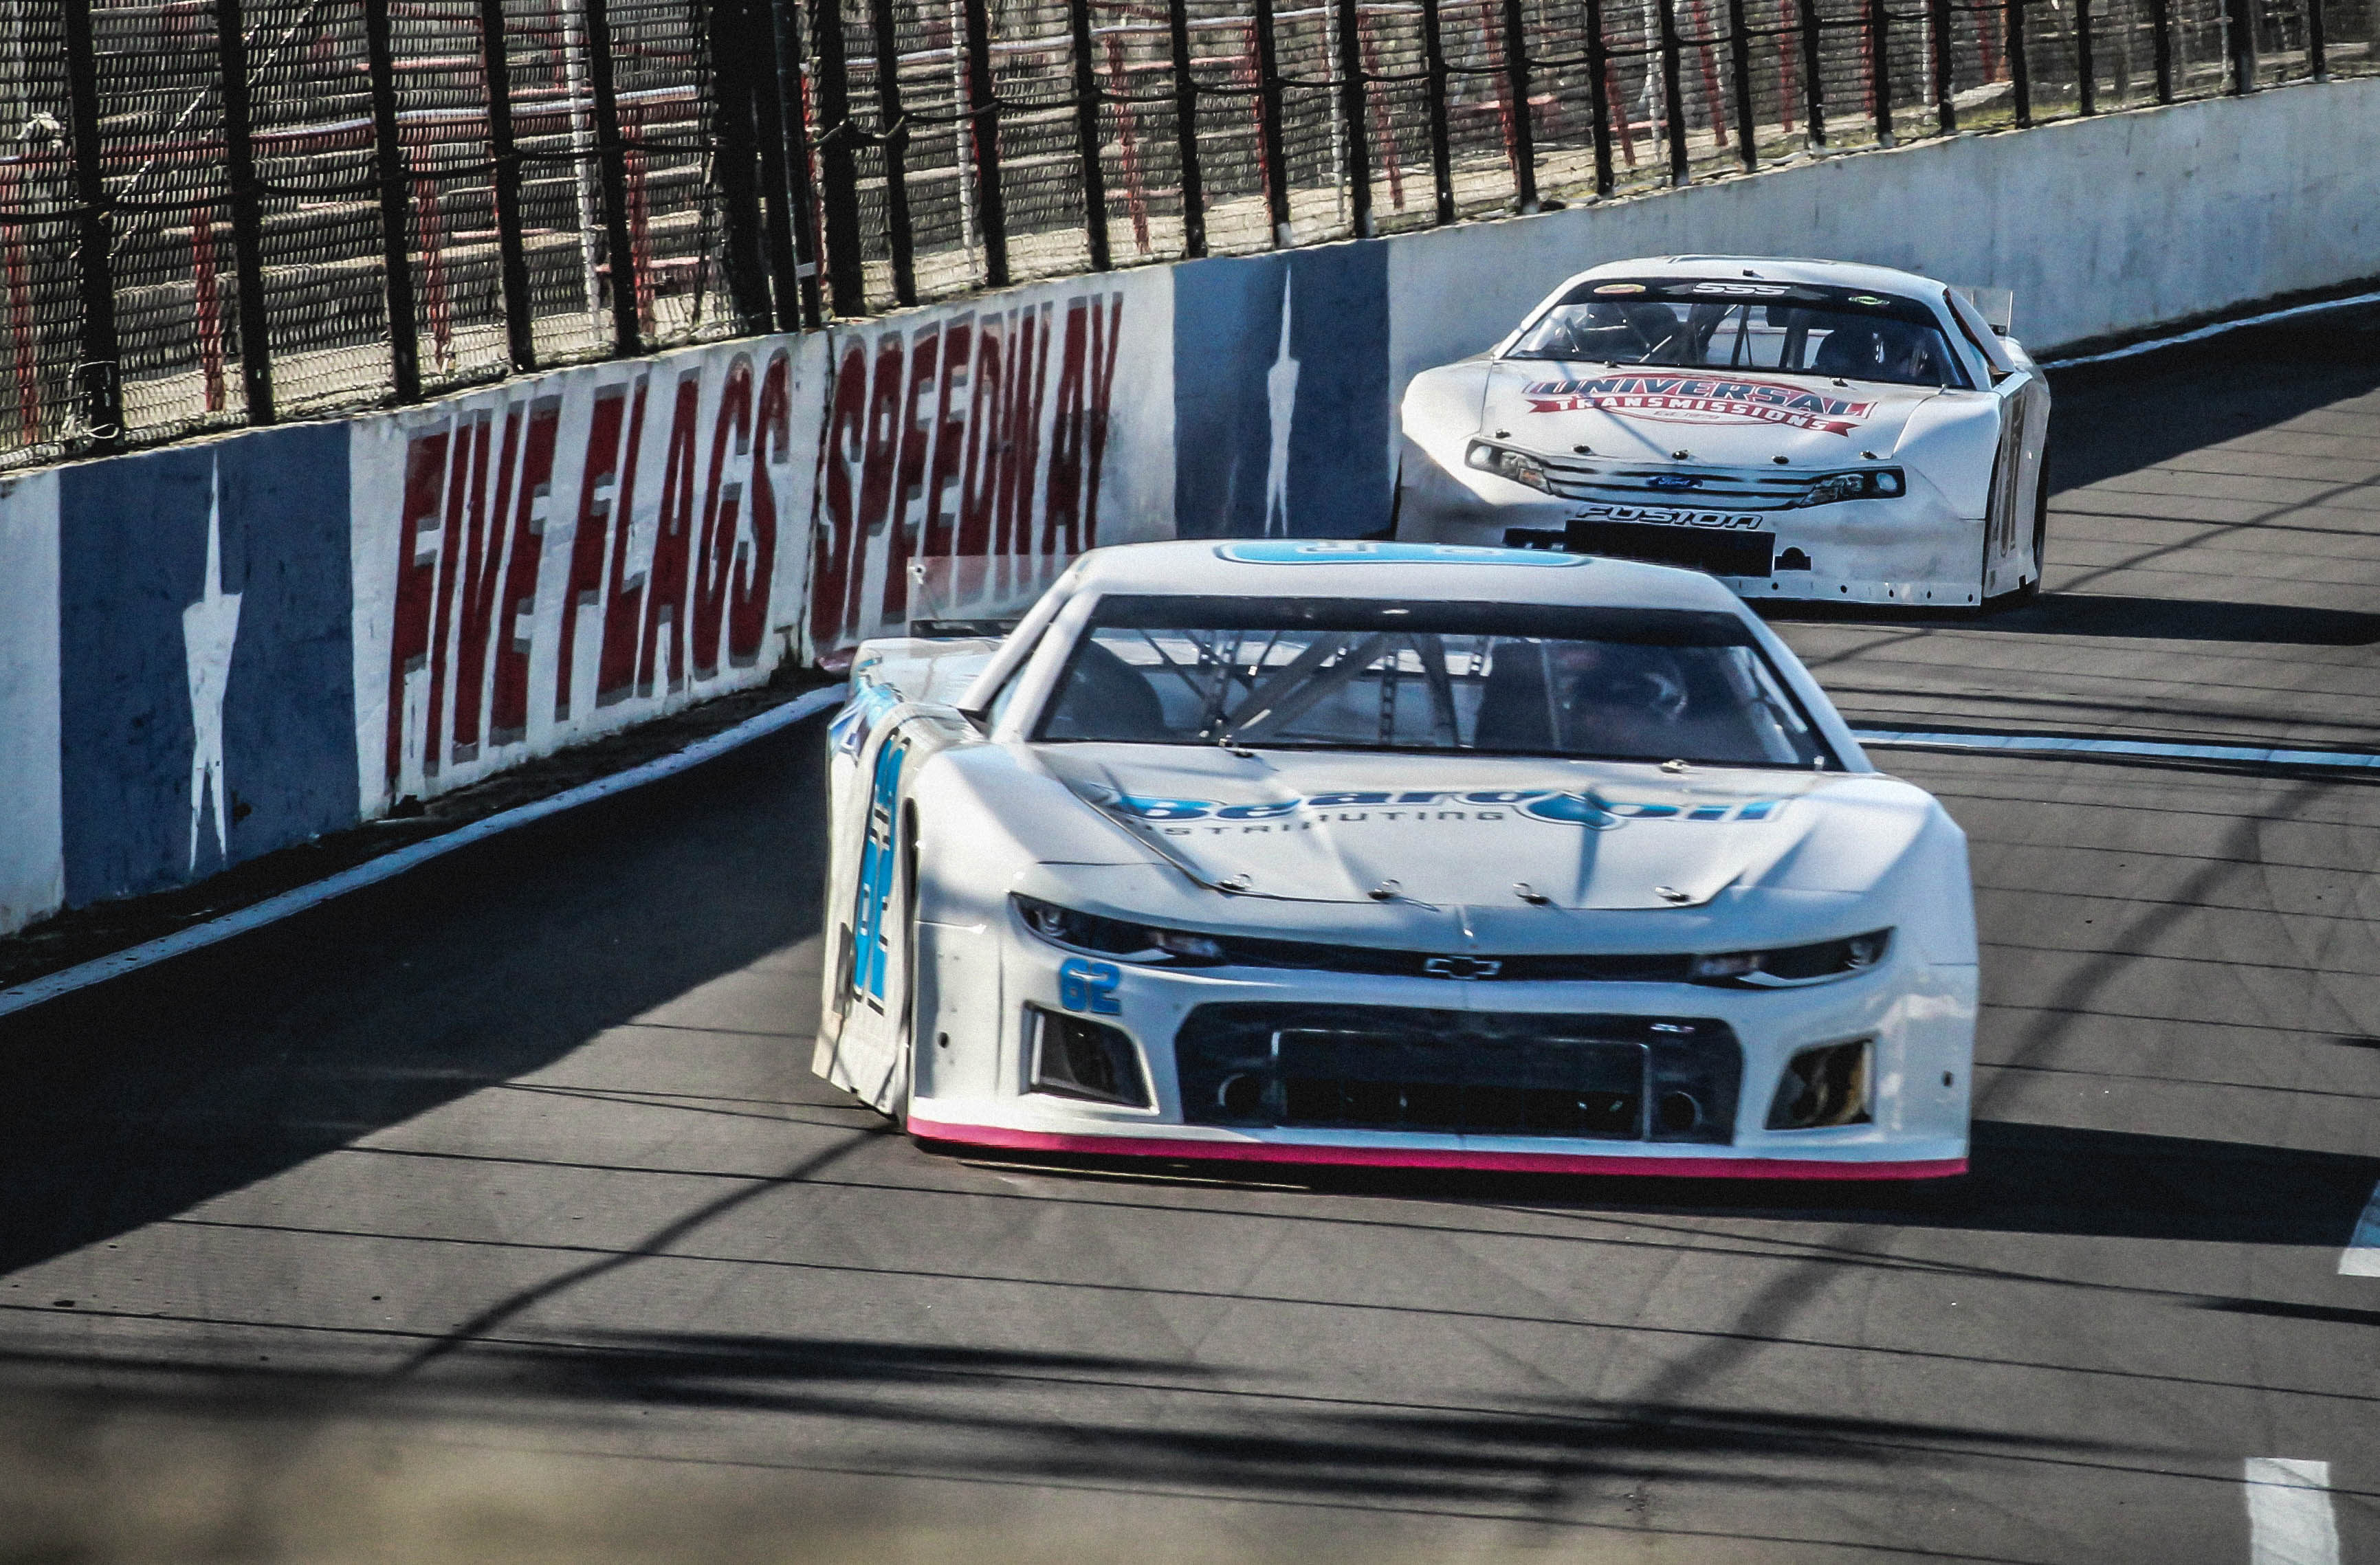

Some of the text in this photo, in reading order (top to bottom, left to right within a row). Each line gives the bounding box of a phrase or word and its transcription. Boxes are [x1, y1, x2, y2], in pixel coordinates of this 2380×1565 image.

[1693, 282, 1790, 296] SSS
[1532, 378, 1871, 418] UNIVERSAL
[1556, 396, 1831, 431] TRANSMISSIONS
[386, 292, 1123, 778] FIVE FLAGS SPEEDWAY
[1576, 506, 1763, 530] FUSION
[1060, 957, 1122, 1016] 62
